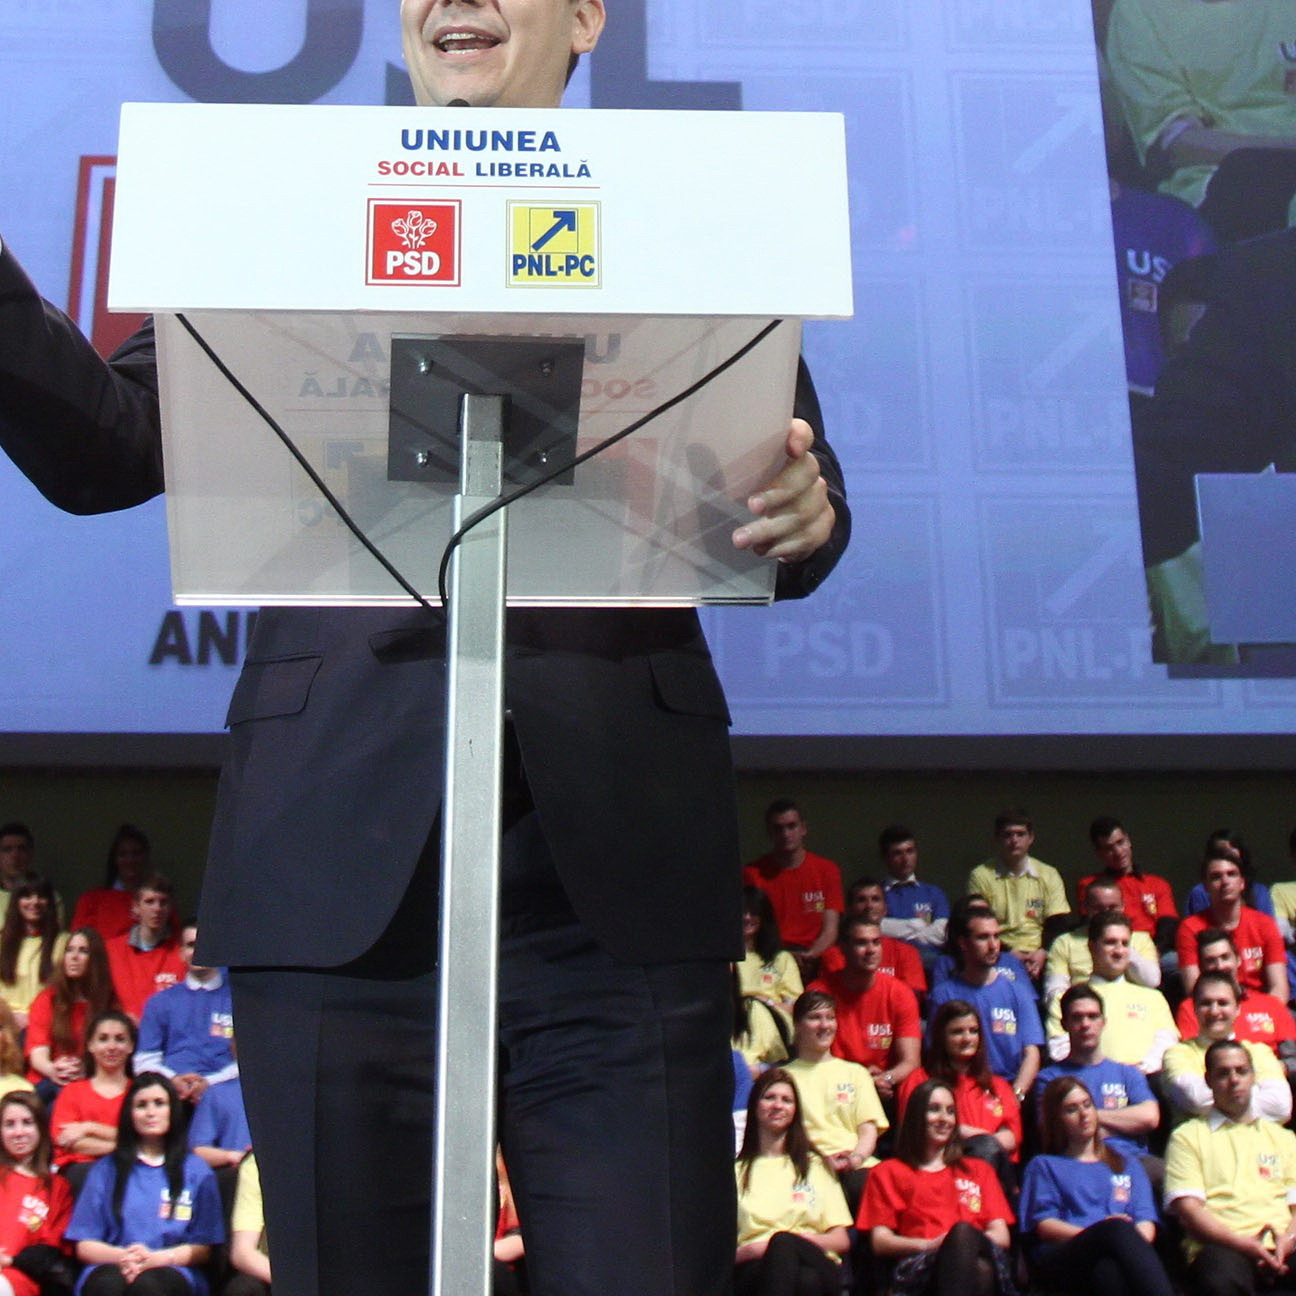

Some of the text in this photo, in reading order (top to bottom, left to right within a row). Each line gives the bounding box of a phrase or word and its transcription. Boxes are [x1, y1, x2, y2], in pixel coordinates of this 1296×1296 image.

[401, 129, 561, 152] UNIUNEA
[378, 159, 592, 178] SOCIAL LIBERALĂ
[386, 251, 441, 275] PSD
[512, 254, 595, 277] PNL-PC
[763, 621, 895, 678] PSD
[992, 1007, 1017, 1021] USL
[868, 1024, 892, 1035] USL
[1102, 1083, 1127, 1096] USL
